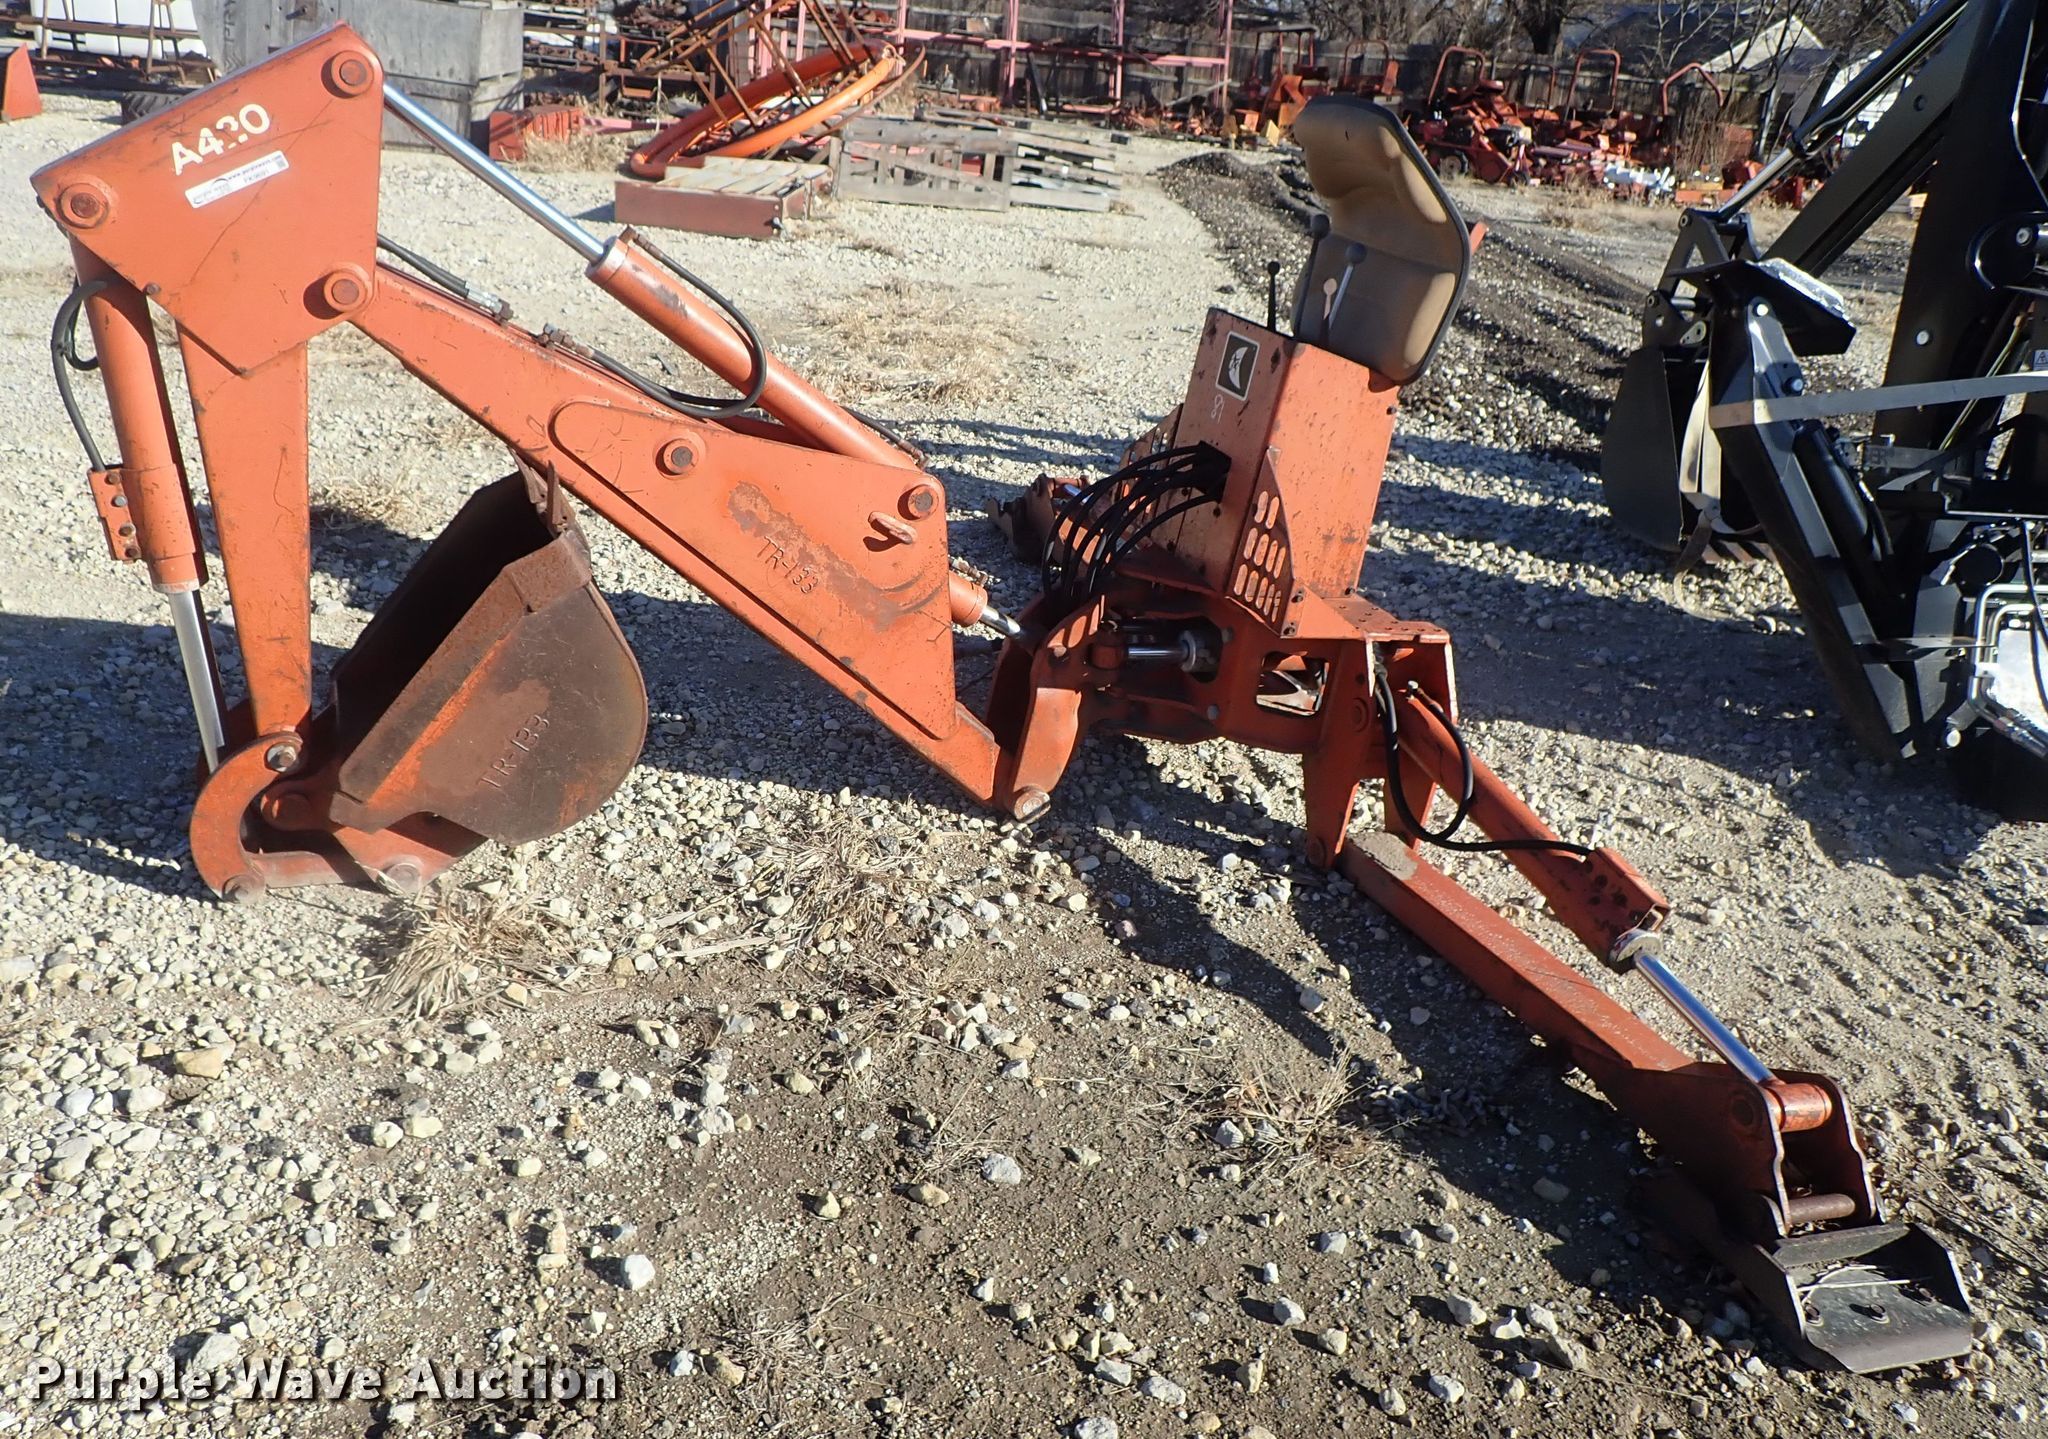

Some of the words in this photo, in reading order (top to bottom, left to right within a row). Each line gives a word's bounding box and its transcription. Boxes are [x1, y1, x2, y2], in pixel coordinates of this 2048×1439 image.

[172, 104, 270, 176] A420
[756, 535, 819, 594] TR-133
[475, 713, 550, 789] TR-133
